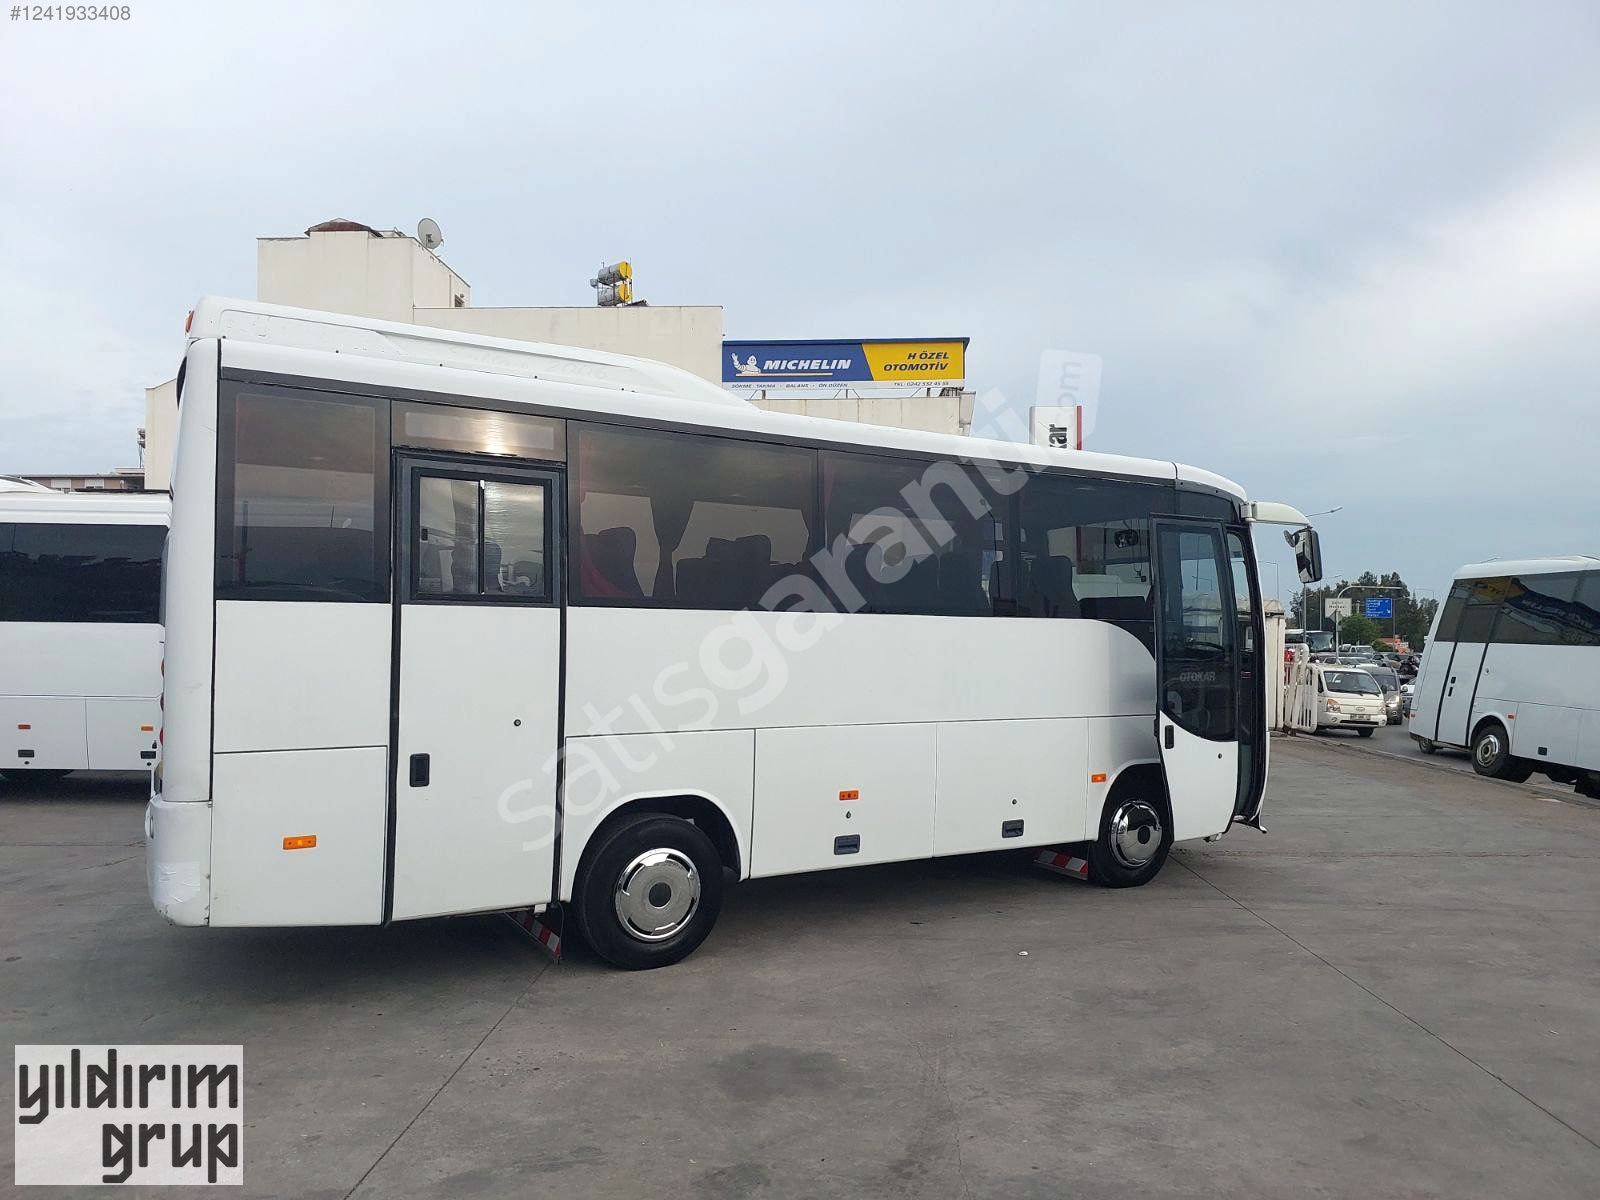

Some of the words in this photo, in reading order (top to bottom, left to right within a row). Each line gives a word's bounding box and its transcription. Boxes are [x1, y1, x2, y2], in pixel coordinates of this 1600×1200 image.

[907, 352, 918, 360] H
[919, 350, 949, 360] ÖZEL
[763, 359, 852, 370] MICHELIN
[883, 361, 949, 372] OTOMOTİV
